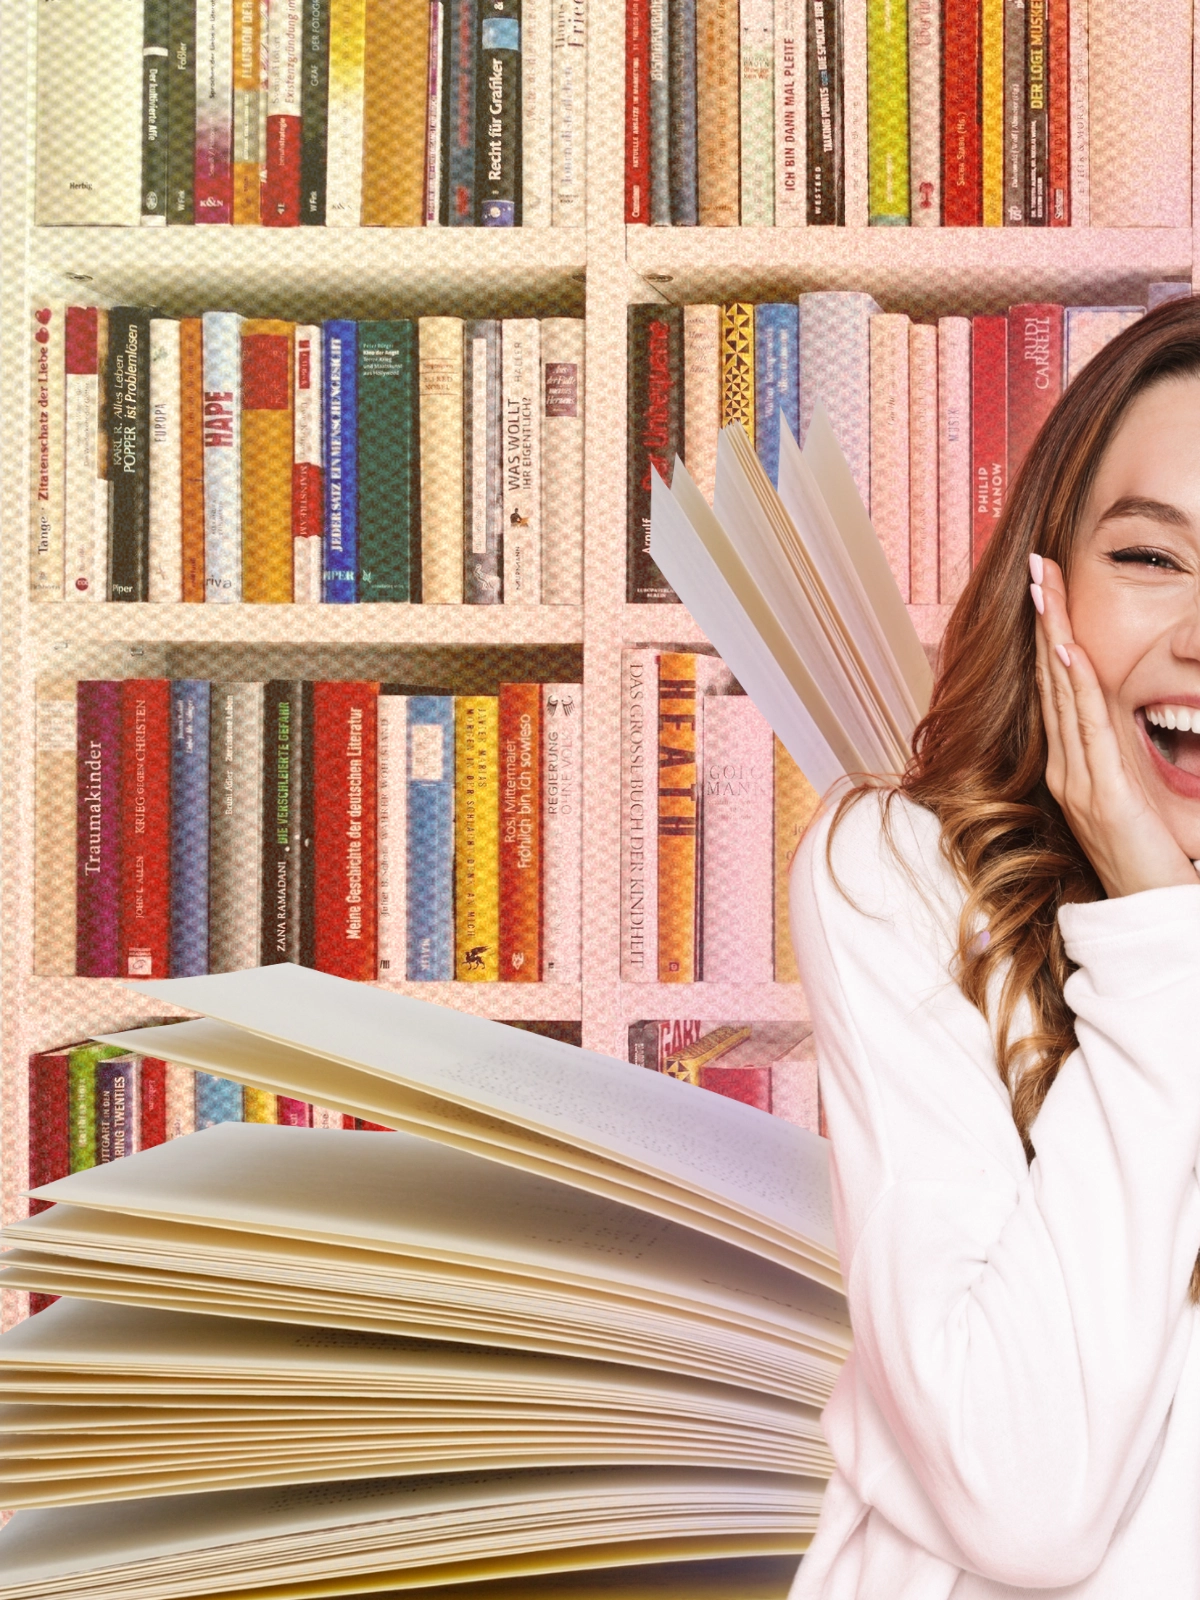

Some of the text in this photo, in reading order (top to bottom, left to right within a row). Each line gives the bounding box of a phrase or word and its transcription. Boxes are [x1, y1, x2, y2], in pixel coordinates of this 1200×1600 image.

[815, 20, 827, 55] SPRACHE
[818, 56, 828, 70] DIE
[311, 64, 319, 86] GRAF
[820, 88, 831, 117] POINTS
[1031, 50, 1044, 109] DER LOGI
[148, 125, 158, 141] Affe
[489, 58, 503, 181] Recht für Grafiker
[784, 38, 795, 191] ICH BIN DANN MAL PLEITE
[822, 119, 832, 152] TALKING
[814, 167, 822, 214] WESTEND
[1024, 317, 1039, 360] RUDI
[1036, 316, 1050, 389] CARRELL
[112, 355, 124, 465] KARL R. Alles Leben
[125, 324, 138, 473] POPPER ist Problemlösen
[643, 320, 674, 448] Unbequeme
[154, 403, 166, 443] EUROPA
[205, 391, 233, 448] HAPE
[330, 337, 343, 552] JEDER SATZ EIN MENSCHENGESICHT
[508, 398, 520, 490] WAS WOLLT
[523, 397, 532, 490] IHR EIGENTLICH?
[37, 347, 50, 554] Tange Zitatenschatz der Liebe
[977, 467, 989, 513] PHILIP
[991, 463, 1002, 518] MANOW
[112, 584, 133, 597] Piper
[278, 701, 290, 742] GEFAHR
[278, 744, 290, 825] VERSCHLEIERTE
[548, 731, 558, 815] REGIERUNG
[658, 679, 697, 837] HEATH
[85, 740, 102, 876] Traumakinder
[134, 699, 146, 919] JOHN ALLEN KRIEG GEGEN CHRISTEN
[504, 739, 516, 843] Rosi Mittermaier
[517, 714, 533, 868] Fröhlich bin ich sowieso
[561, 772, 572, 815] OHNE
[629, 663, 645, 969] DAS GROSSE BUCH DER KINDHEIT
[345, 706, 362, 940] Meine Geschichte der deutschen Literatur
[276, 860, 286, 920] RAMADANI
[276, 922, 287, 952] ZANA
[101, 1091, 110, 1107] DEN
[113, 1076, 125, 1127] TWENTIES
[101, 1121, 111, 1165] UTTGART
